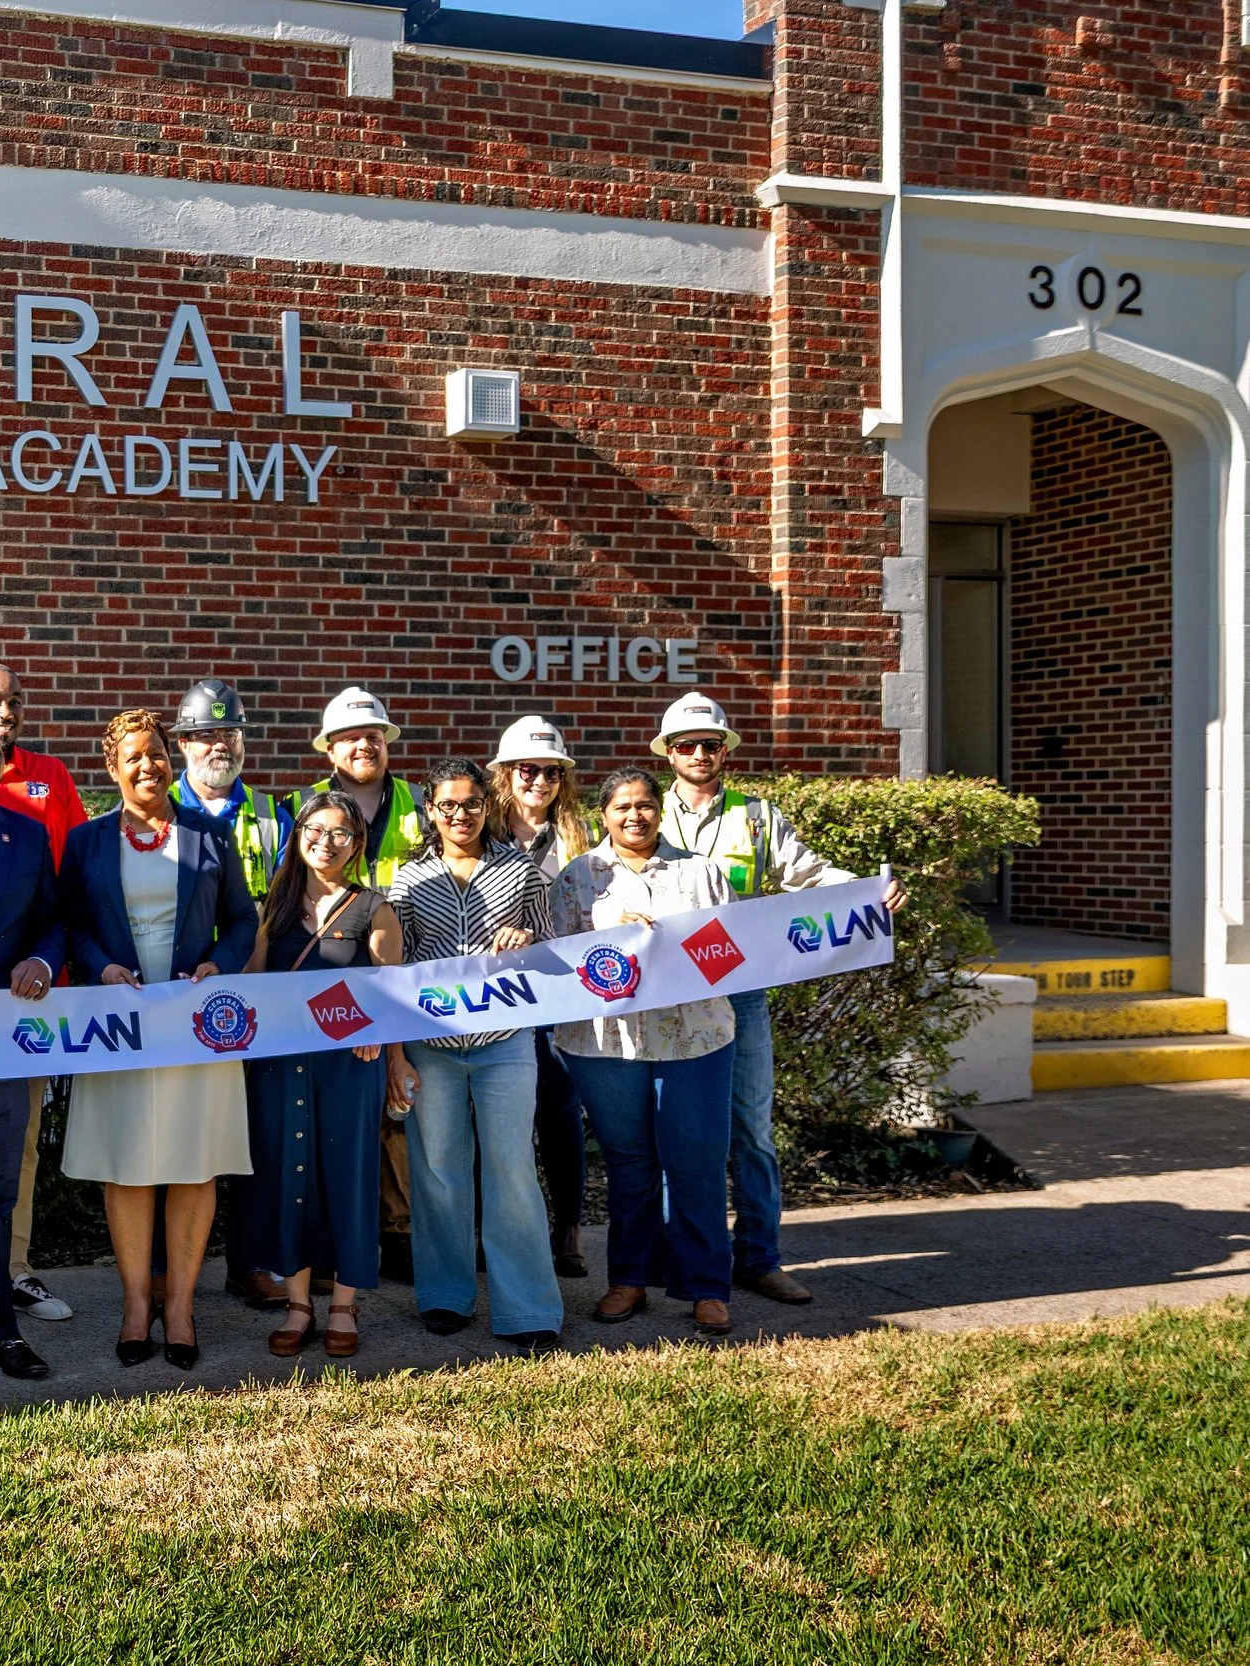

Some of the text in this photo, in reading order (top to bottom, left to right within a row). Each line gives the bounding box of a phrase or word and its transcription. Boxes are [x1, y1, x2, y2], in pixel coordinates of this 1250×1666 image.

[1028, 265, 1143, 317] 302
[490, 635, 699, 684] OFFICE
[823, 901, 892, 947] LAN
[588, 950, 620, 965] CENTRAL
[690, 941, 737, 962] WRA
[455, 973, 538, 1013] LAN
[1056, 971, 1092, 989] YOUR
[1100, 969, 1135, 987] STEP
[207, 997, 240, 1012] CENTRAL
[314, 1006, 364, 1024] WRA
[58, 1011, 143, 1053] LAN
